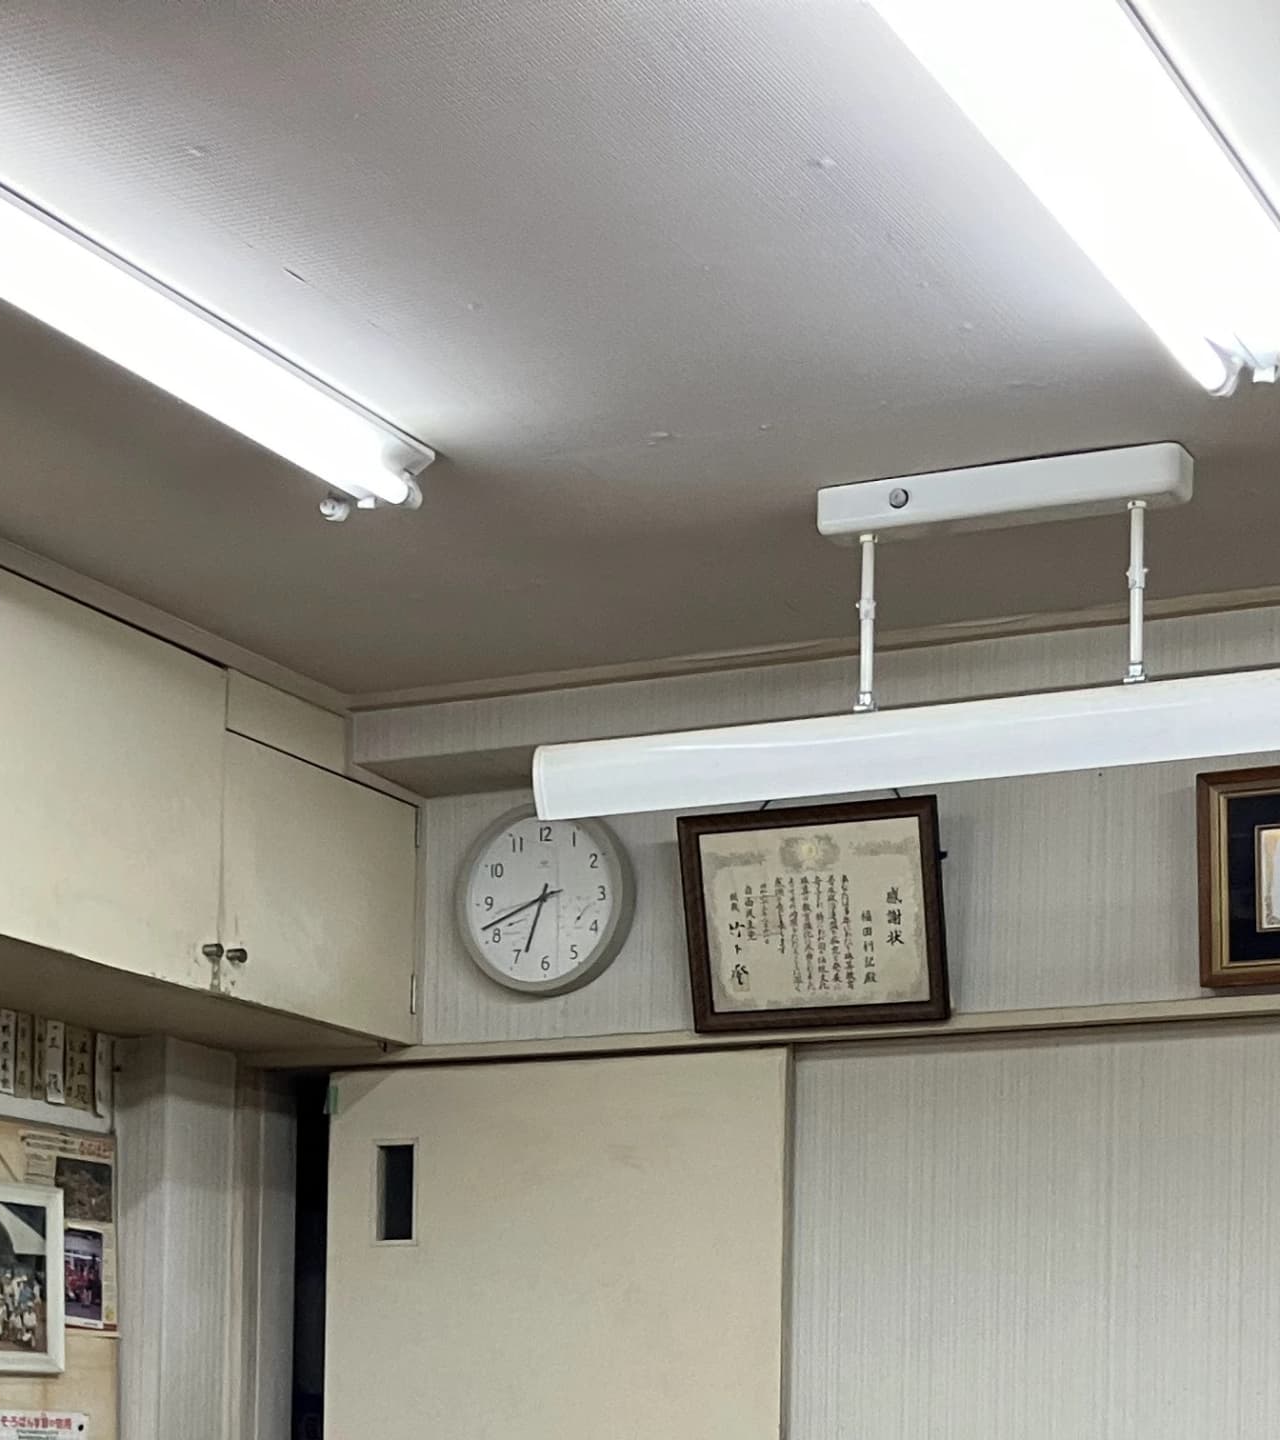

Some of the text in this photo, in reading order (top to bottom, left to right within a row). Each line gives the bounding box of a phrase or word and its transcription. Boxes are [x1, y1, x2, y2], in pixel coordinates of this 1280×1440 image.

[539, 826, 553, 842] 12
[572, 831, 577, 847] 1
[512, 836, 524, 853] 11
[589, 853, 599, 869] 2
[490, 863, 504, 879] 10
[597, 885, 607, 901] 3
[484, 896, 494, 912] 9
[886, 886, 905, 946] 感謝状
[588, 919, 599, 935] 4
[492, 928, 502, 943] 8
[512, 949, 522, 965] 7
[569, 944, 579, 960] 5
[540, 955, 551, 971] 6
